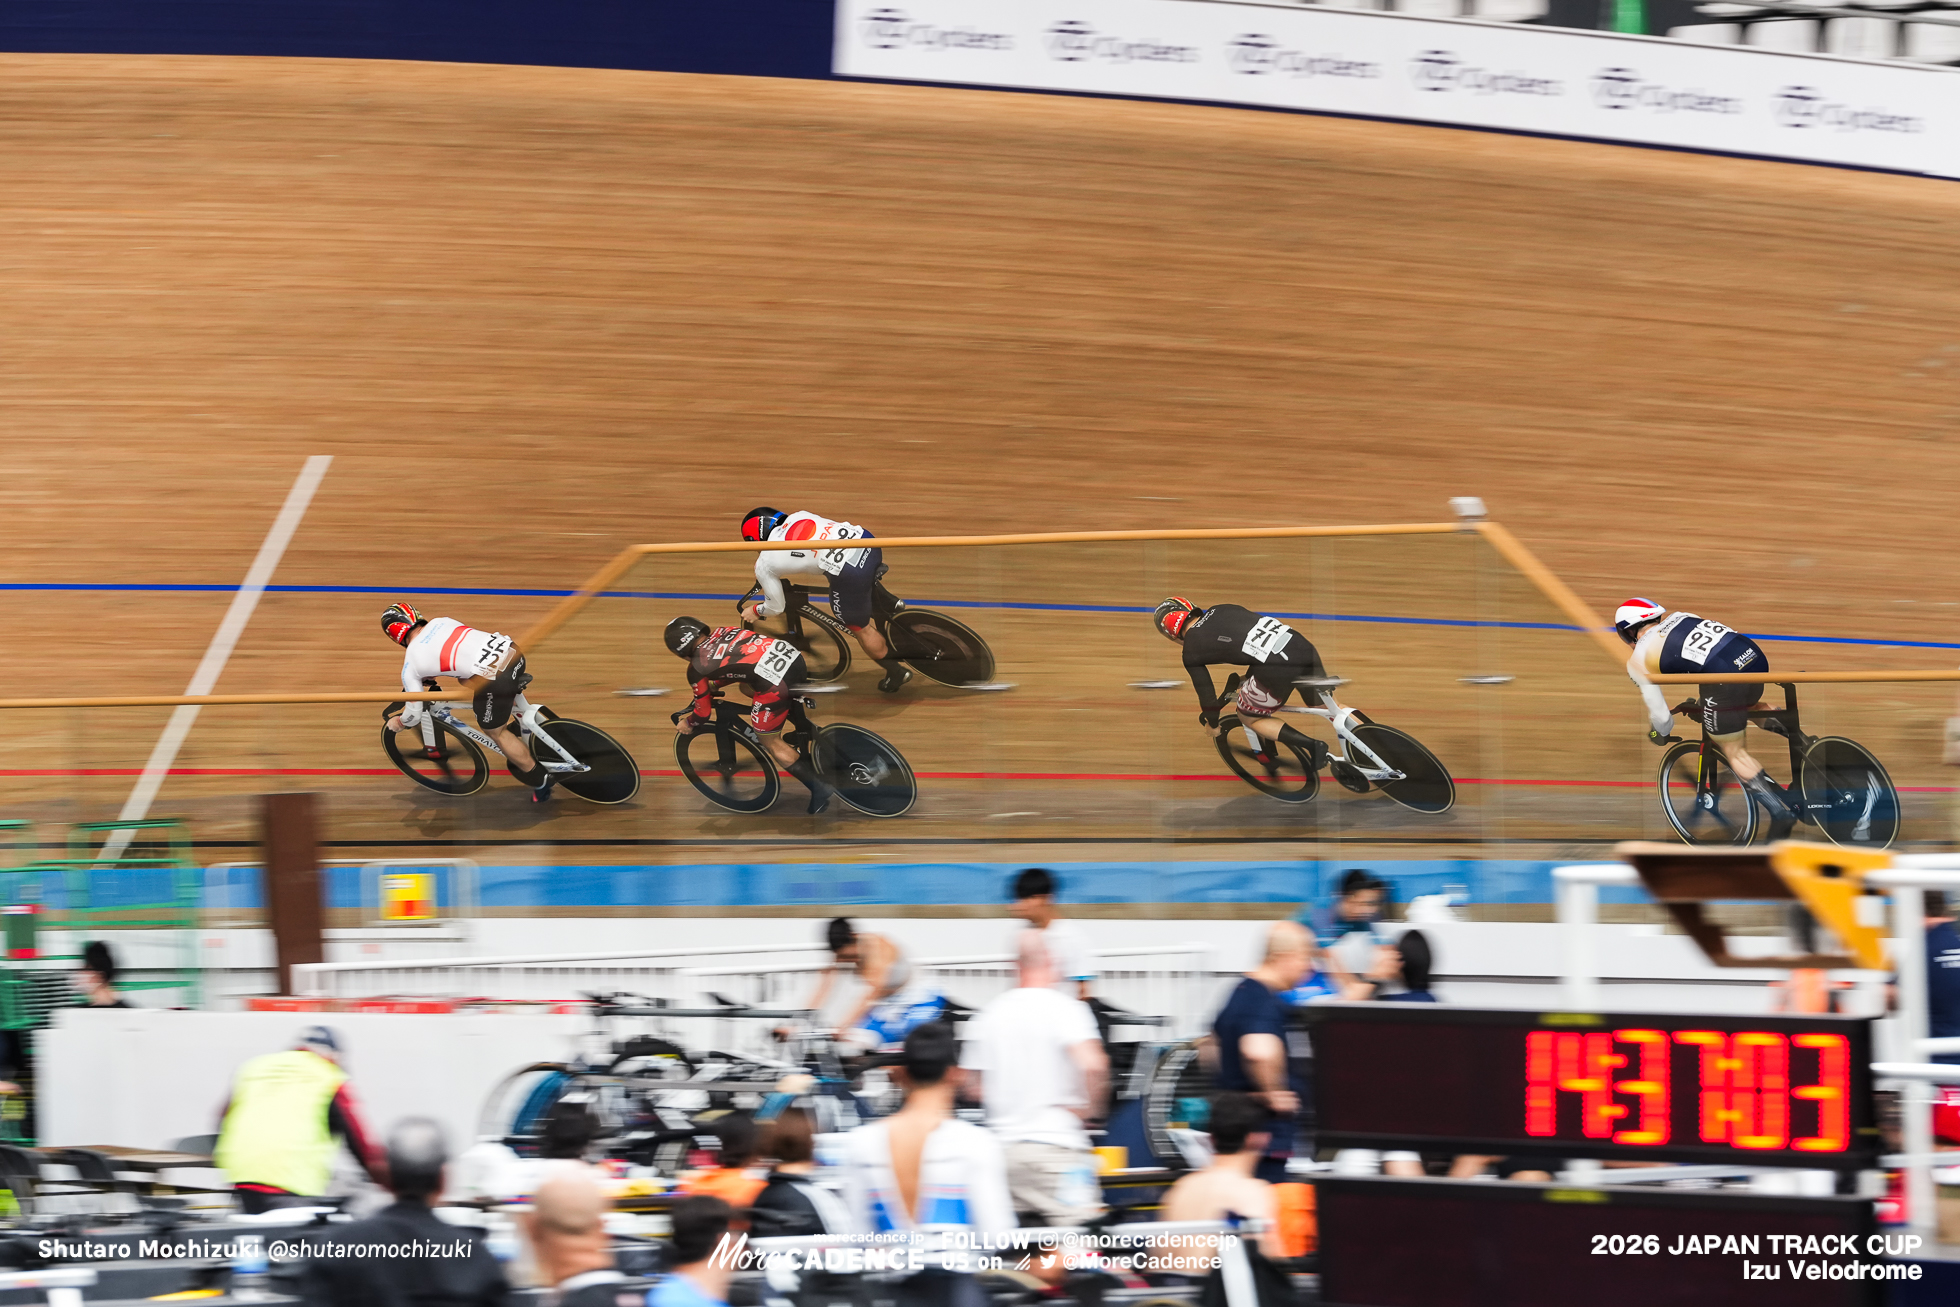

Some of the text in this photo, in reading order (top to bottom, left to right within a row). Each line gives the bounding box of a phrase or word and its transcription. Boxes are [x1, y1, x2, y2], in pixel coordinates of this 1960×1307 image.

[1250, 628, 1273, 648] 71
[1688, 632, 1713, 652] 92
[478, 648, 500, 669] 72
[764, 651, 787, 673] 70
